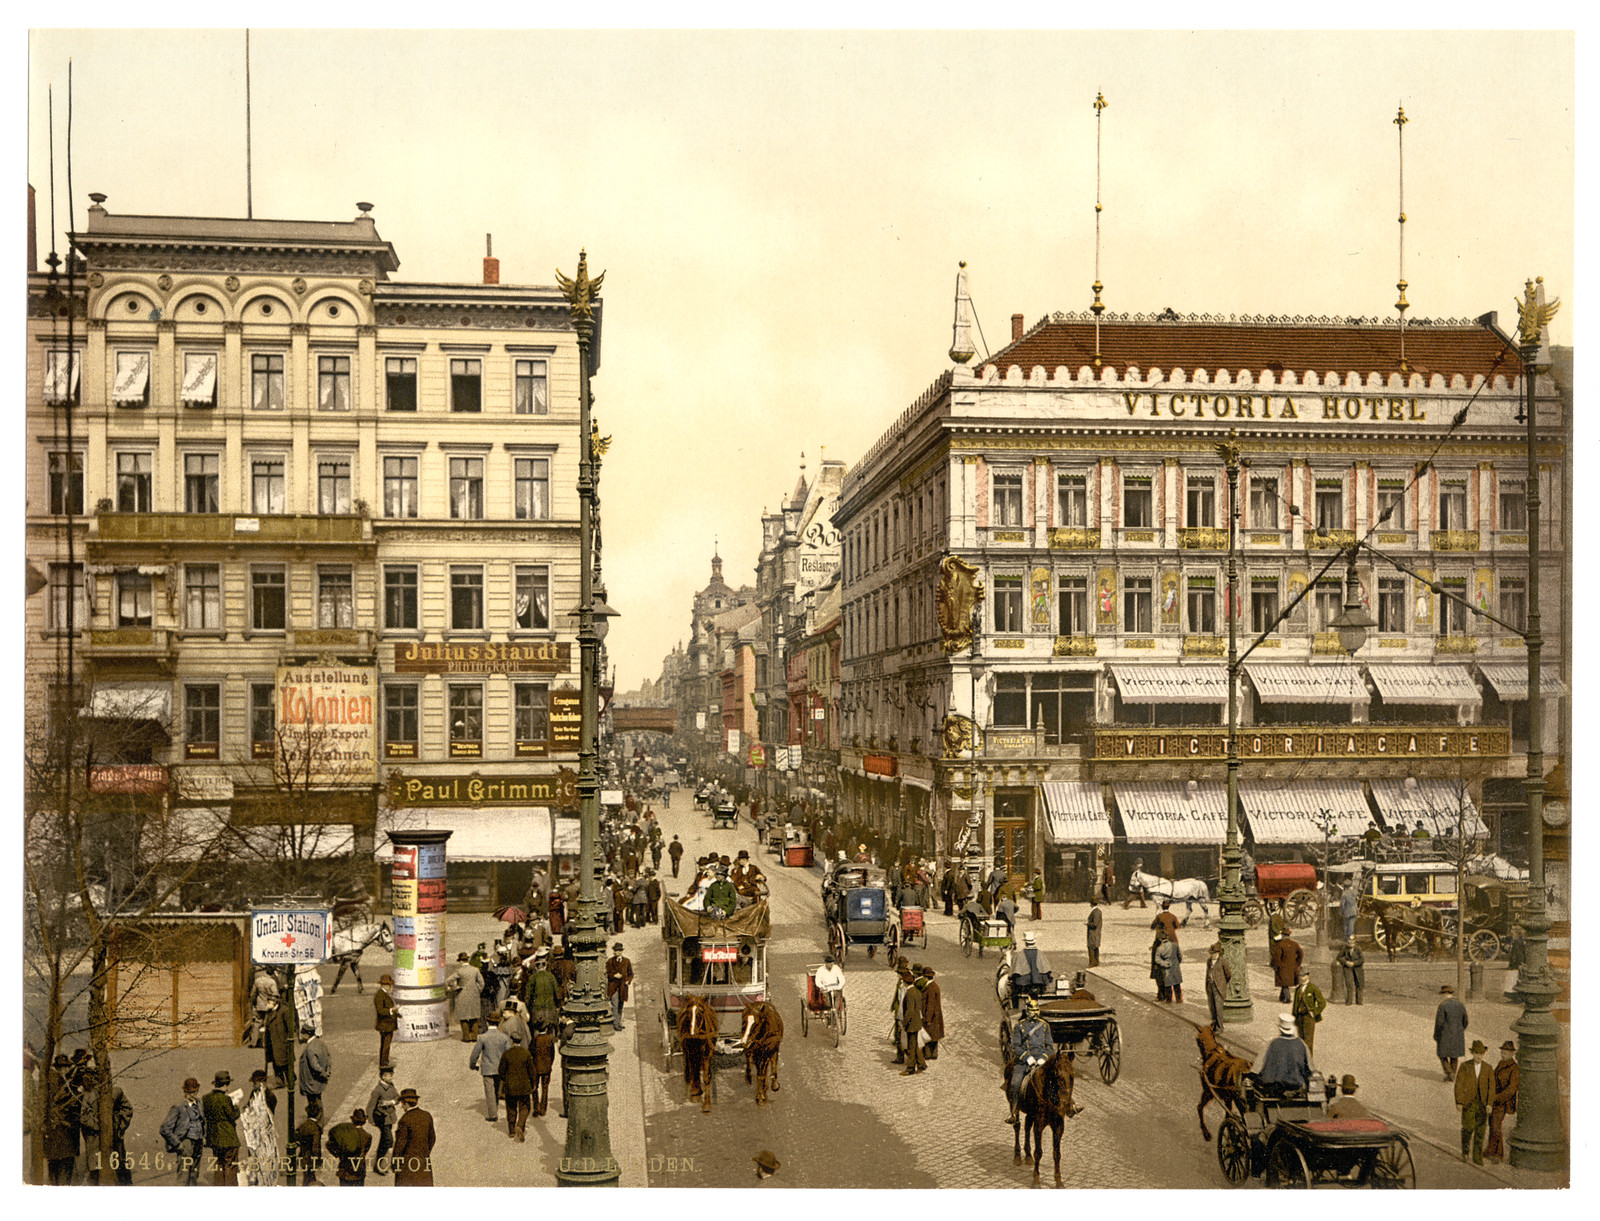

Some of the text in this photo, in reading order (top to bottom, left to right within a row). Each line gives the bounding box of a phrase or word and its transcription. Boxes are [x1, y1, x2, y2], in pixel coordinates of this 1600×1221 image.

[1122, 392, 1427, 421] VICTORIA HOTEL
[405, 642, 559, 660] Julius Staudt
[283, 671, 369, 686] Ausstellung
[280, 686, 373, 725] Kolonien
[1125, 736, 1479, 754] VICTORIA CAFE
[405, 778, 459, 801] Paul
[256, 914, 321, 939] Unfall Station
